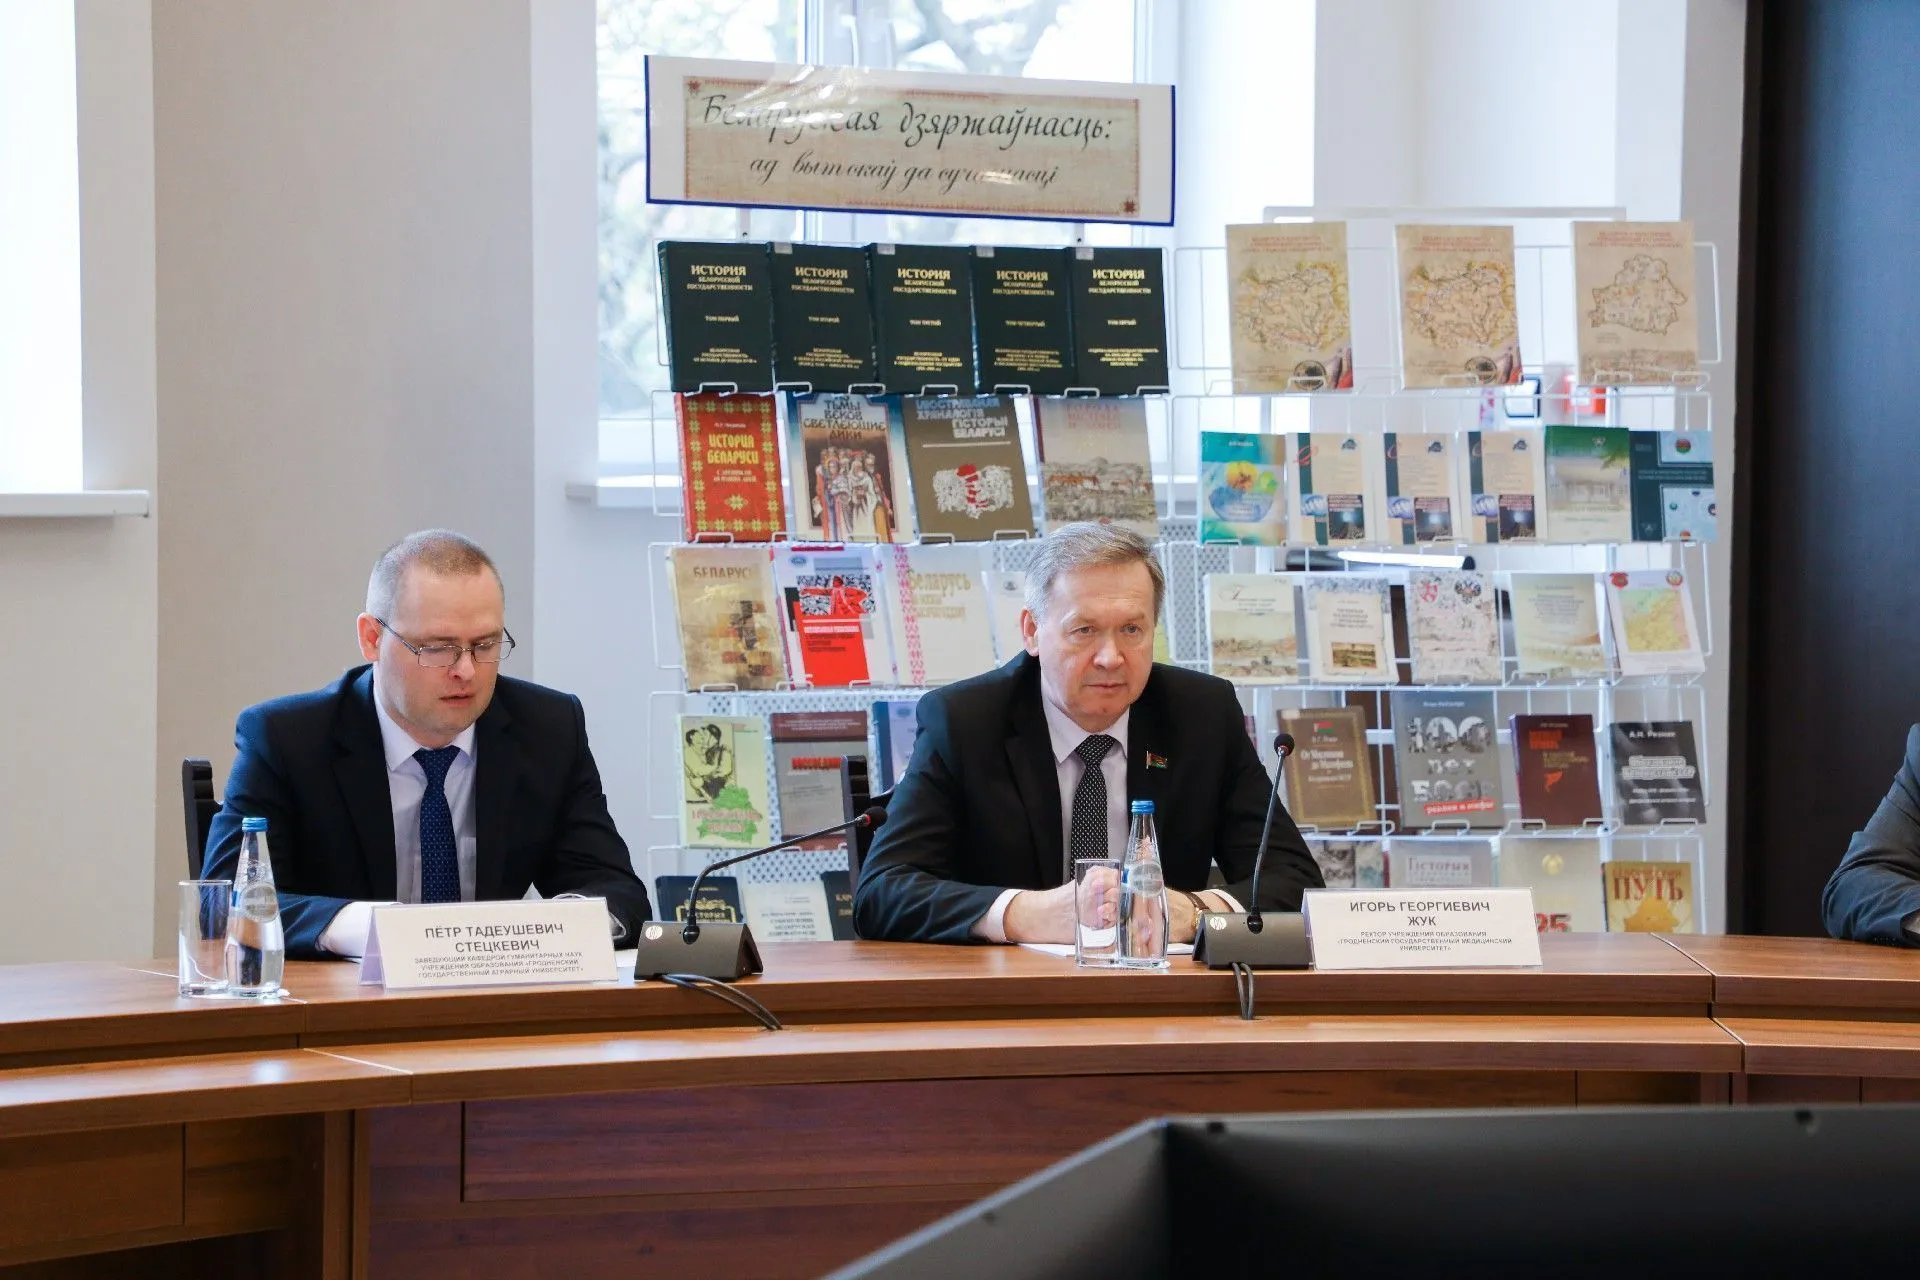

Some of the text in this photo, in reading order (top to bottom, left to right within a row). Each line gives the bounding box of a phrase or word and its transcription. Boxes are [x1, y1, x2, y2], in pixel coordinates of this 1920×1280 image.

[899, 102, 1111, 151] дзяржаўнасць:
[750, 156, 779, 185] ад
[901, 166, 933, 192] да
[691, 265, 747, 276] ИСТОРИЯ
[795, 266, 848, 279] ИСТОРИЯ
[897, 268, 951, 280] ИСТОРИЯ
[996, 270, 1049, 281] ИСТОРИЯ
[1092, 269, 1145, 280] ИСТОРИЯ
[1614, 877, 1683, 900] ПУТЬ
[1350, 901, 1490, 912] ИГОРЬ ГЕОРГИЕВИЧ
[1407, 916, 1437, 926] ЖУК
[425, 923, 564, 939] ПЁТР ТАДЕУШЕВИЧ
[455, 940, 540, 954] СТЕЦКЕВИЧ
